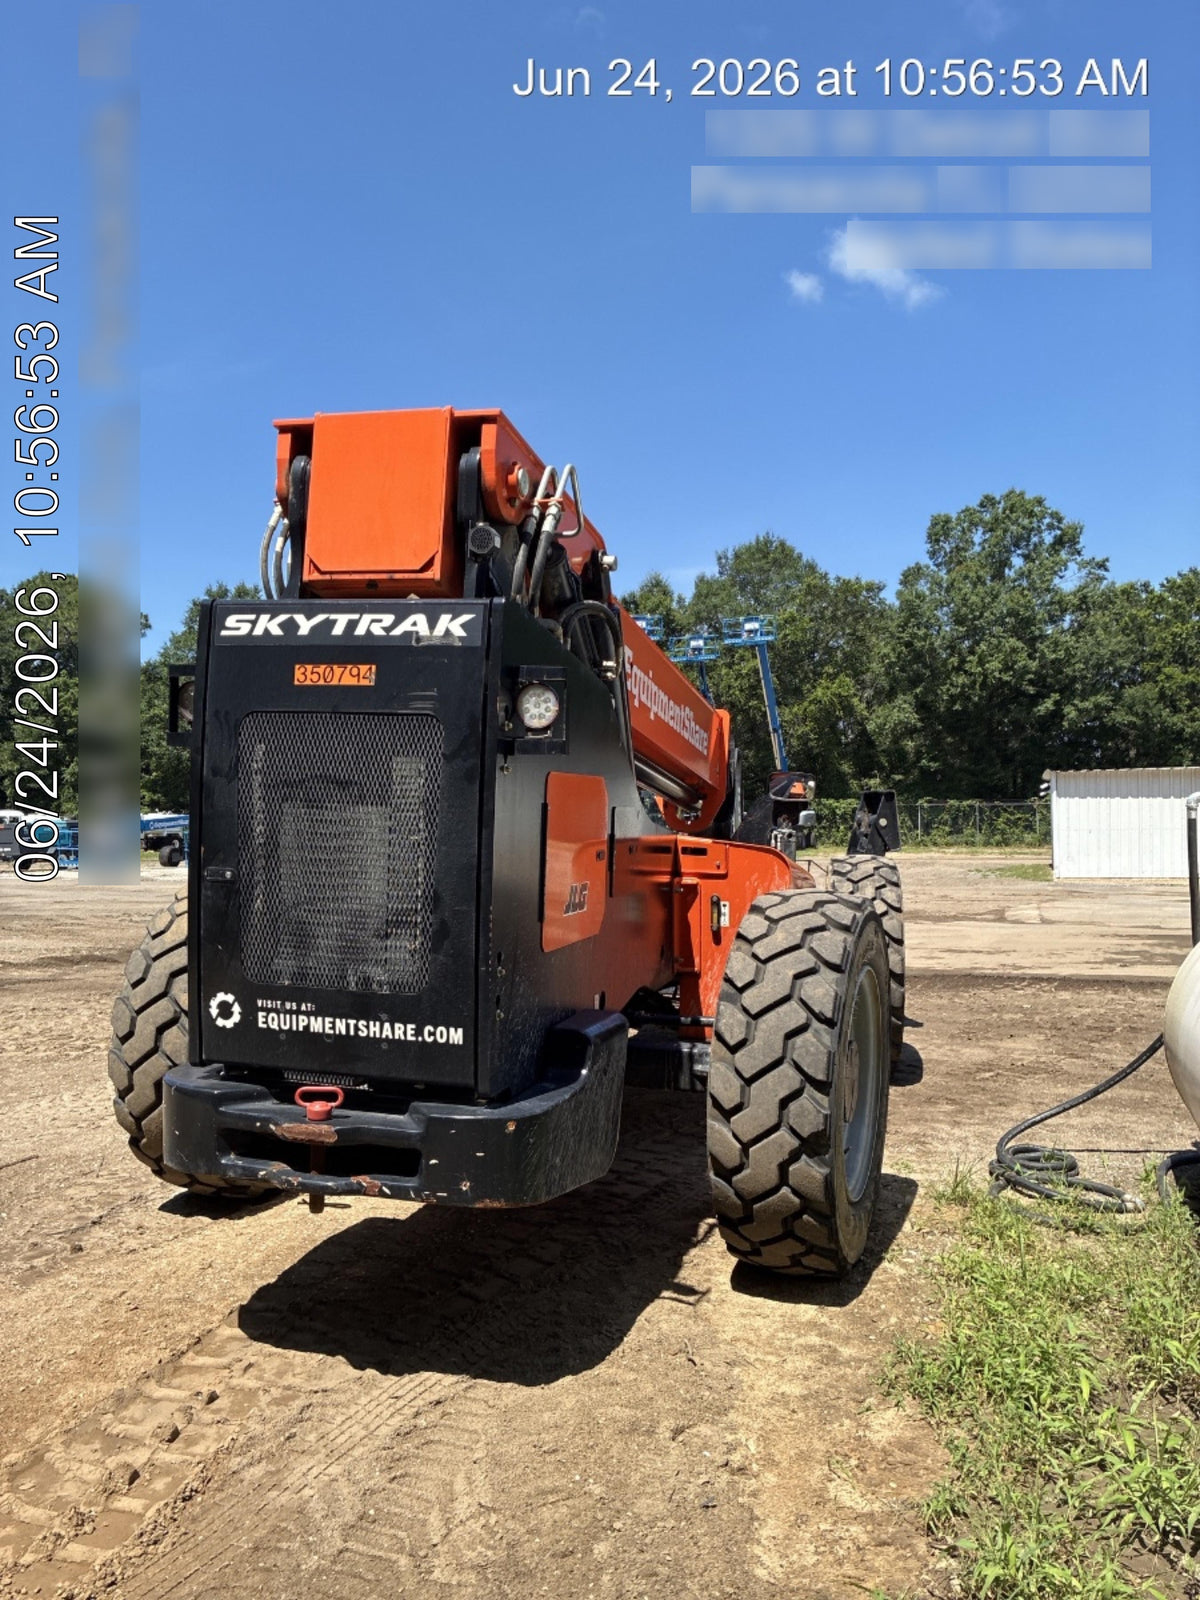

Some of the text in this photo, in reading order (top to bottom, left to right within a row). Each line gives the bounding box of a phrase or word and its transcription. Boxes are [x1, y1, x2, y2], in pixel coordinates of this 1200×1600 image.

[220, 613, 476, 637] SKYTRAK
[296, 664, 373, 684] 350794
[623, 644, 709, 756] EquipmentShare
[563, 881, 590, 916] JLG
[257, 998, 315, 1011] VISIT US AT:
[257, 1012, 464, 1045] EQUIPMENTSHARE.COM
